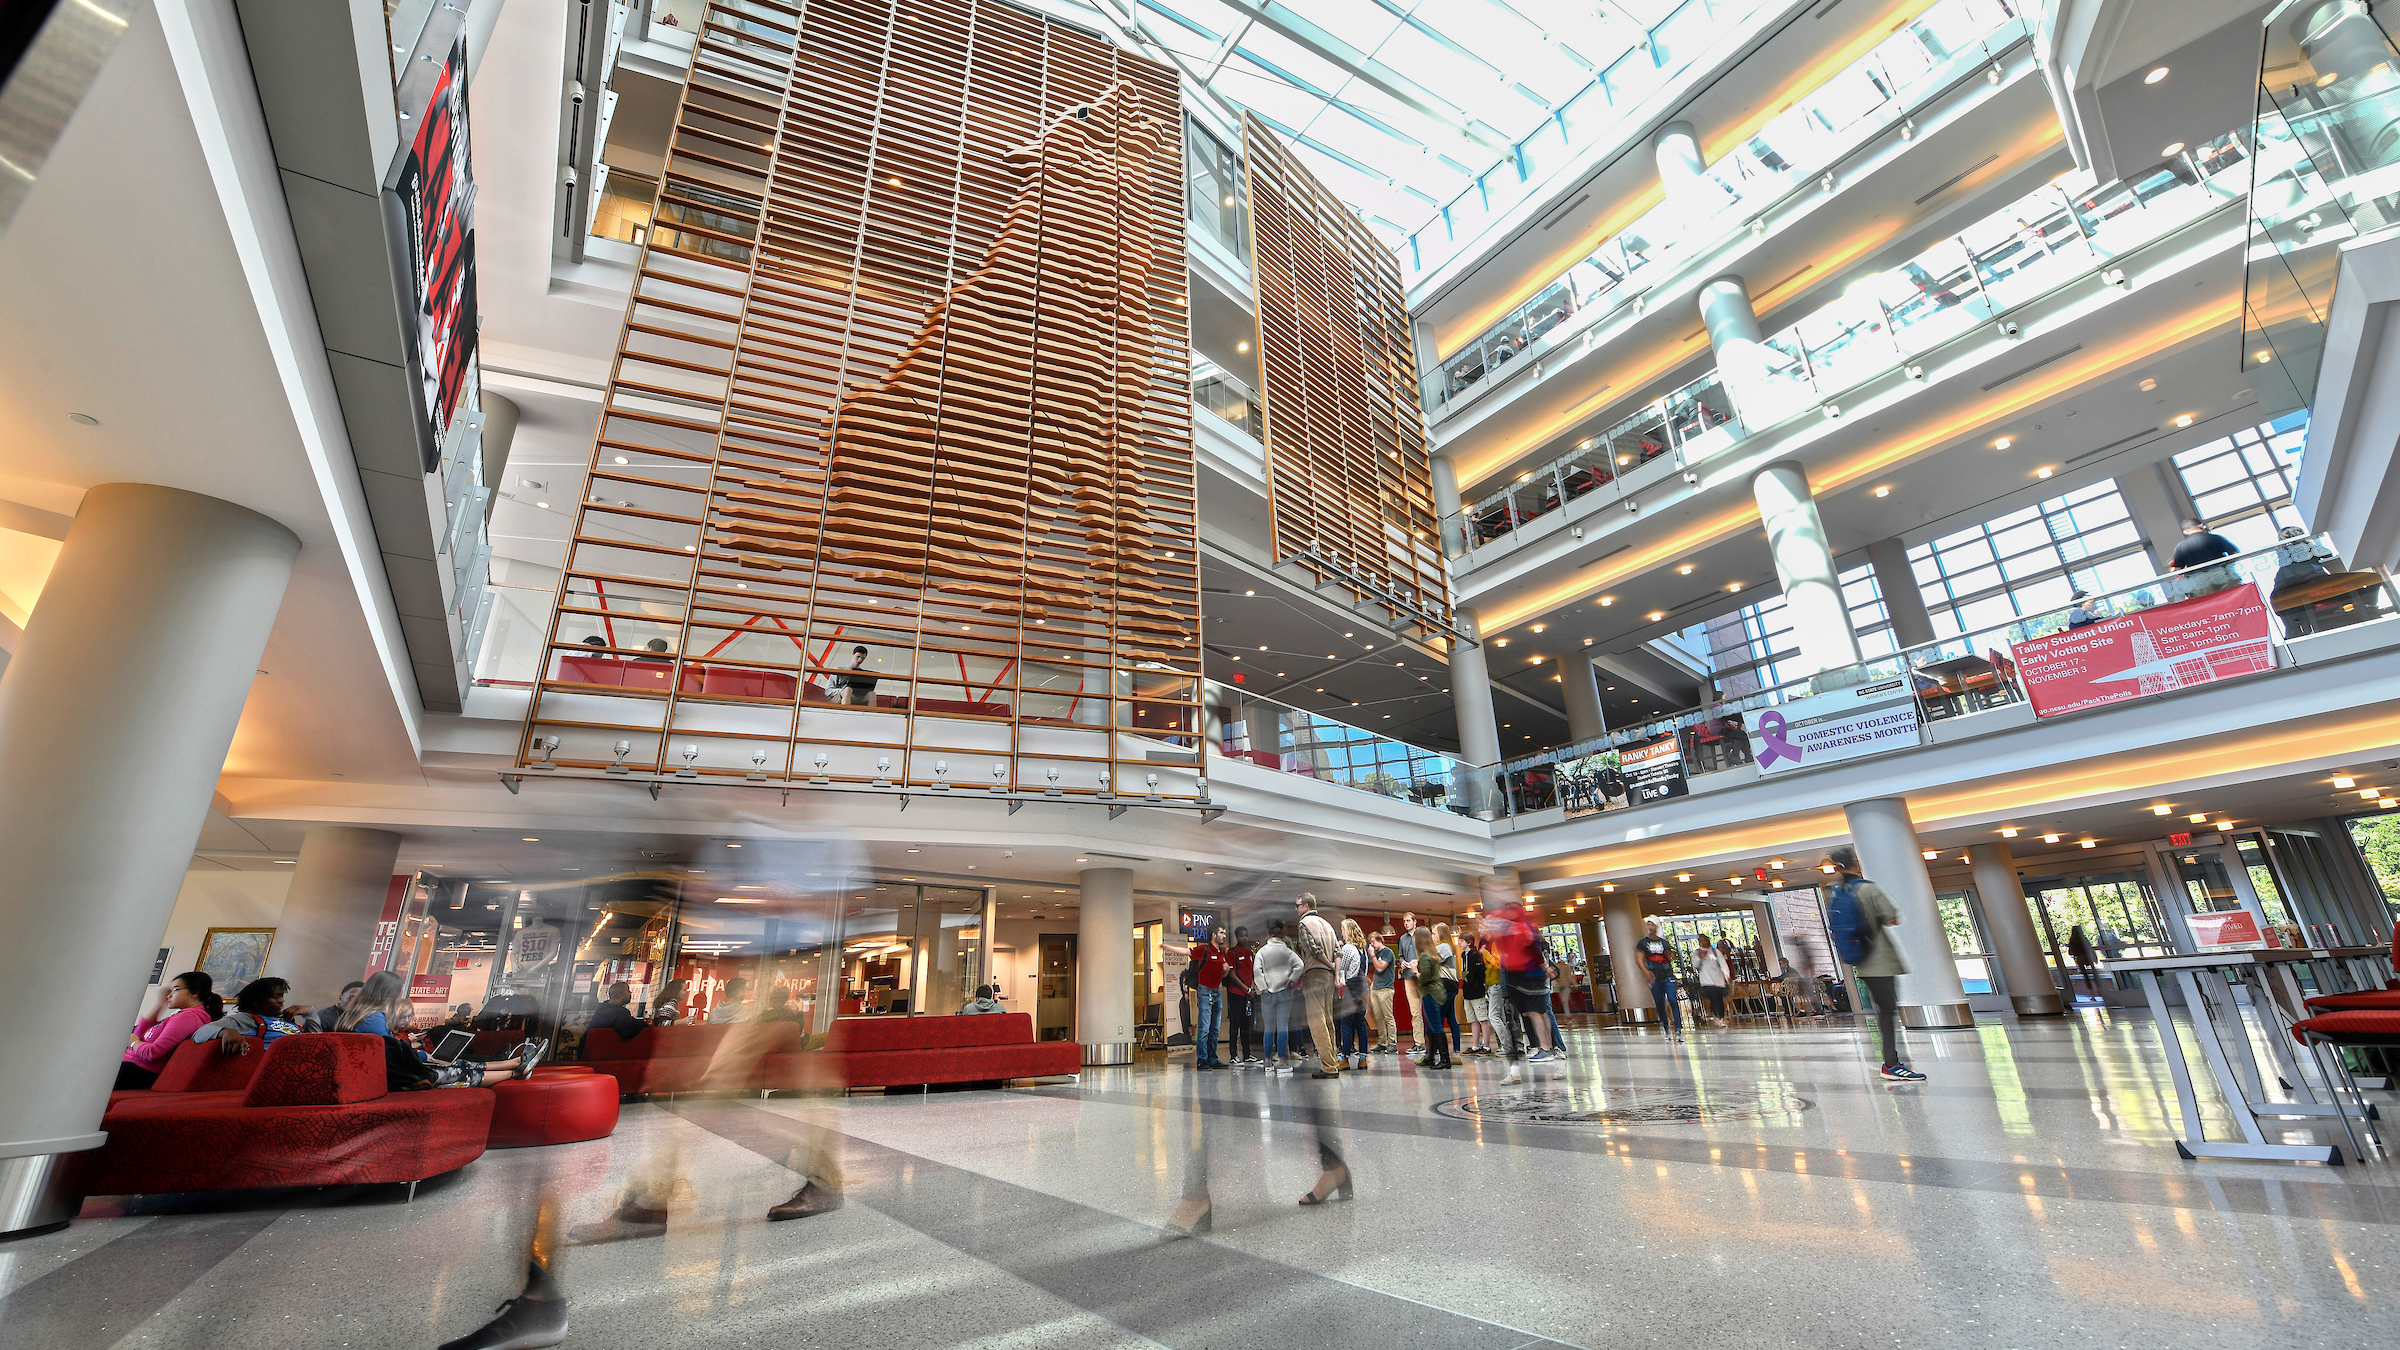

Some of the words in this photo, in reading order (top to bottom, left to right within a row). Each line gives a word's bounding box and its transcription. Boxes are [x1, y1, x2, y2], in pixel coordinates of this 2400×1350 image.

[2156, 618, 2210, 635] Weekdays:
[2212, 604, 2262, 622] 7am-7pm
[2016, 642, 2048, 655] Talley
[2051, 628, 2096, 646] Student
[2098, 620, 2134, 634] Union
[2161, 634, 2180, 644] Sat:
[2182, 622, 2231, 640] 8am-1pm
[2165, 642, 2188, 654] Sun:
[2190, 631, 2240, 648] 1pm-6pm
[2020, 653, 2048, 666] Early
[2050, 644, 2089, 658] Voting
[2090, 637, 2114, 649] Site
[2024, 660, 2068, 677] OCTOBER
[2069, 658, 2080, 666] 17
[2028, 668, 2080, 686] NOVEMBER
[1866, 692, 1887, 700] WOMEN'S
[2038, 690, 2132, 715] go.ncsu.edu/PackThePolls
[1794, 718, 1818, 728] OCTOBER
[1798, 724, 1854, 743] DOMESTIC
[1855, 711, 1914, 730] VIOLENCE
[1807, 732, 1872, 752] AWARENESS
[1874, 722, 1918, 739] MONTH
[1621, 749, 1648, 763] RANKY
[1650, 740, 1675, 756] TANKY
[1642, 790, 1659, 800] LIVE
[2170, 832, 2191, 846] EXIT
[1193, 928, 1208, 940] BA
[522, 939, 546, 953] $10
[520, 952, 544, 962] TEES
